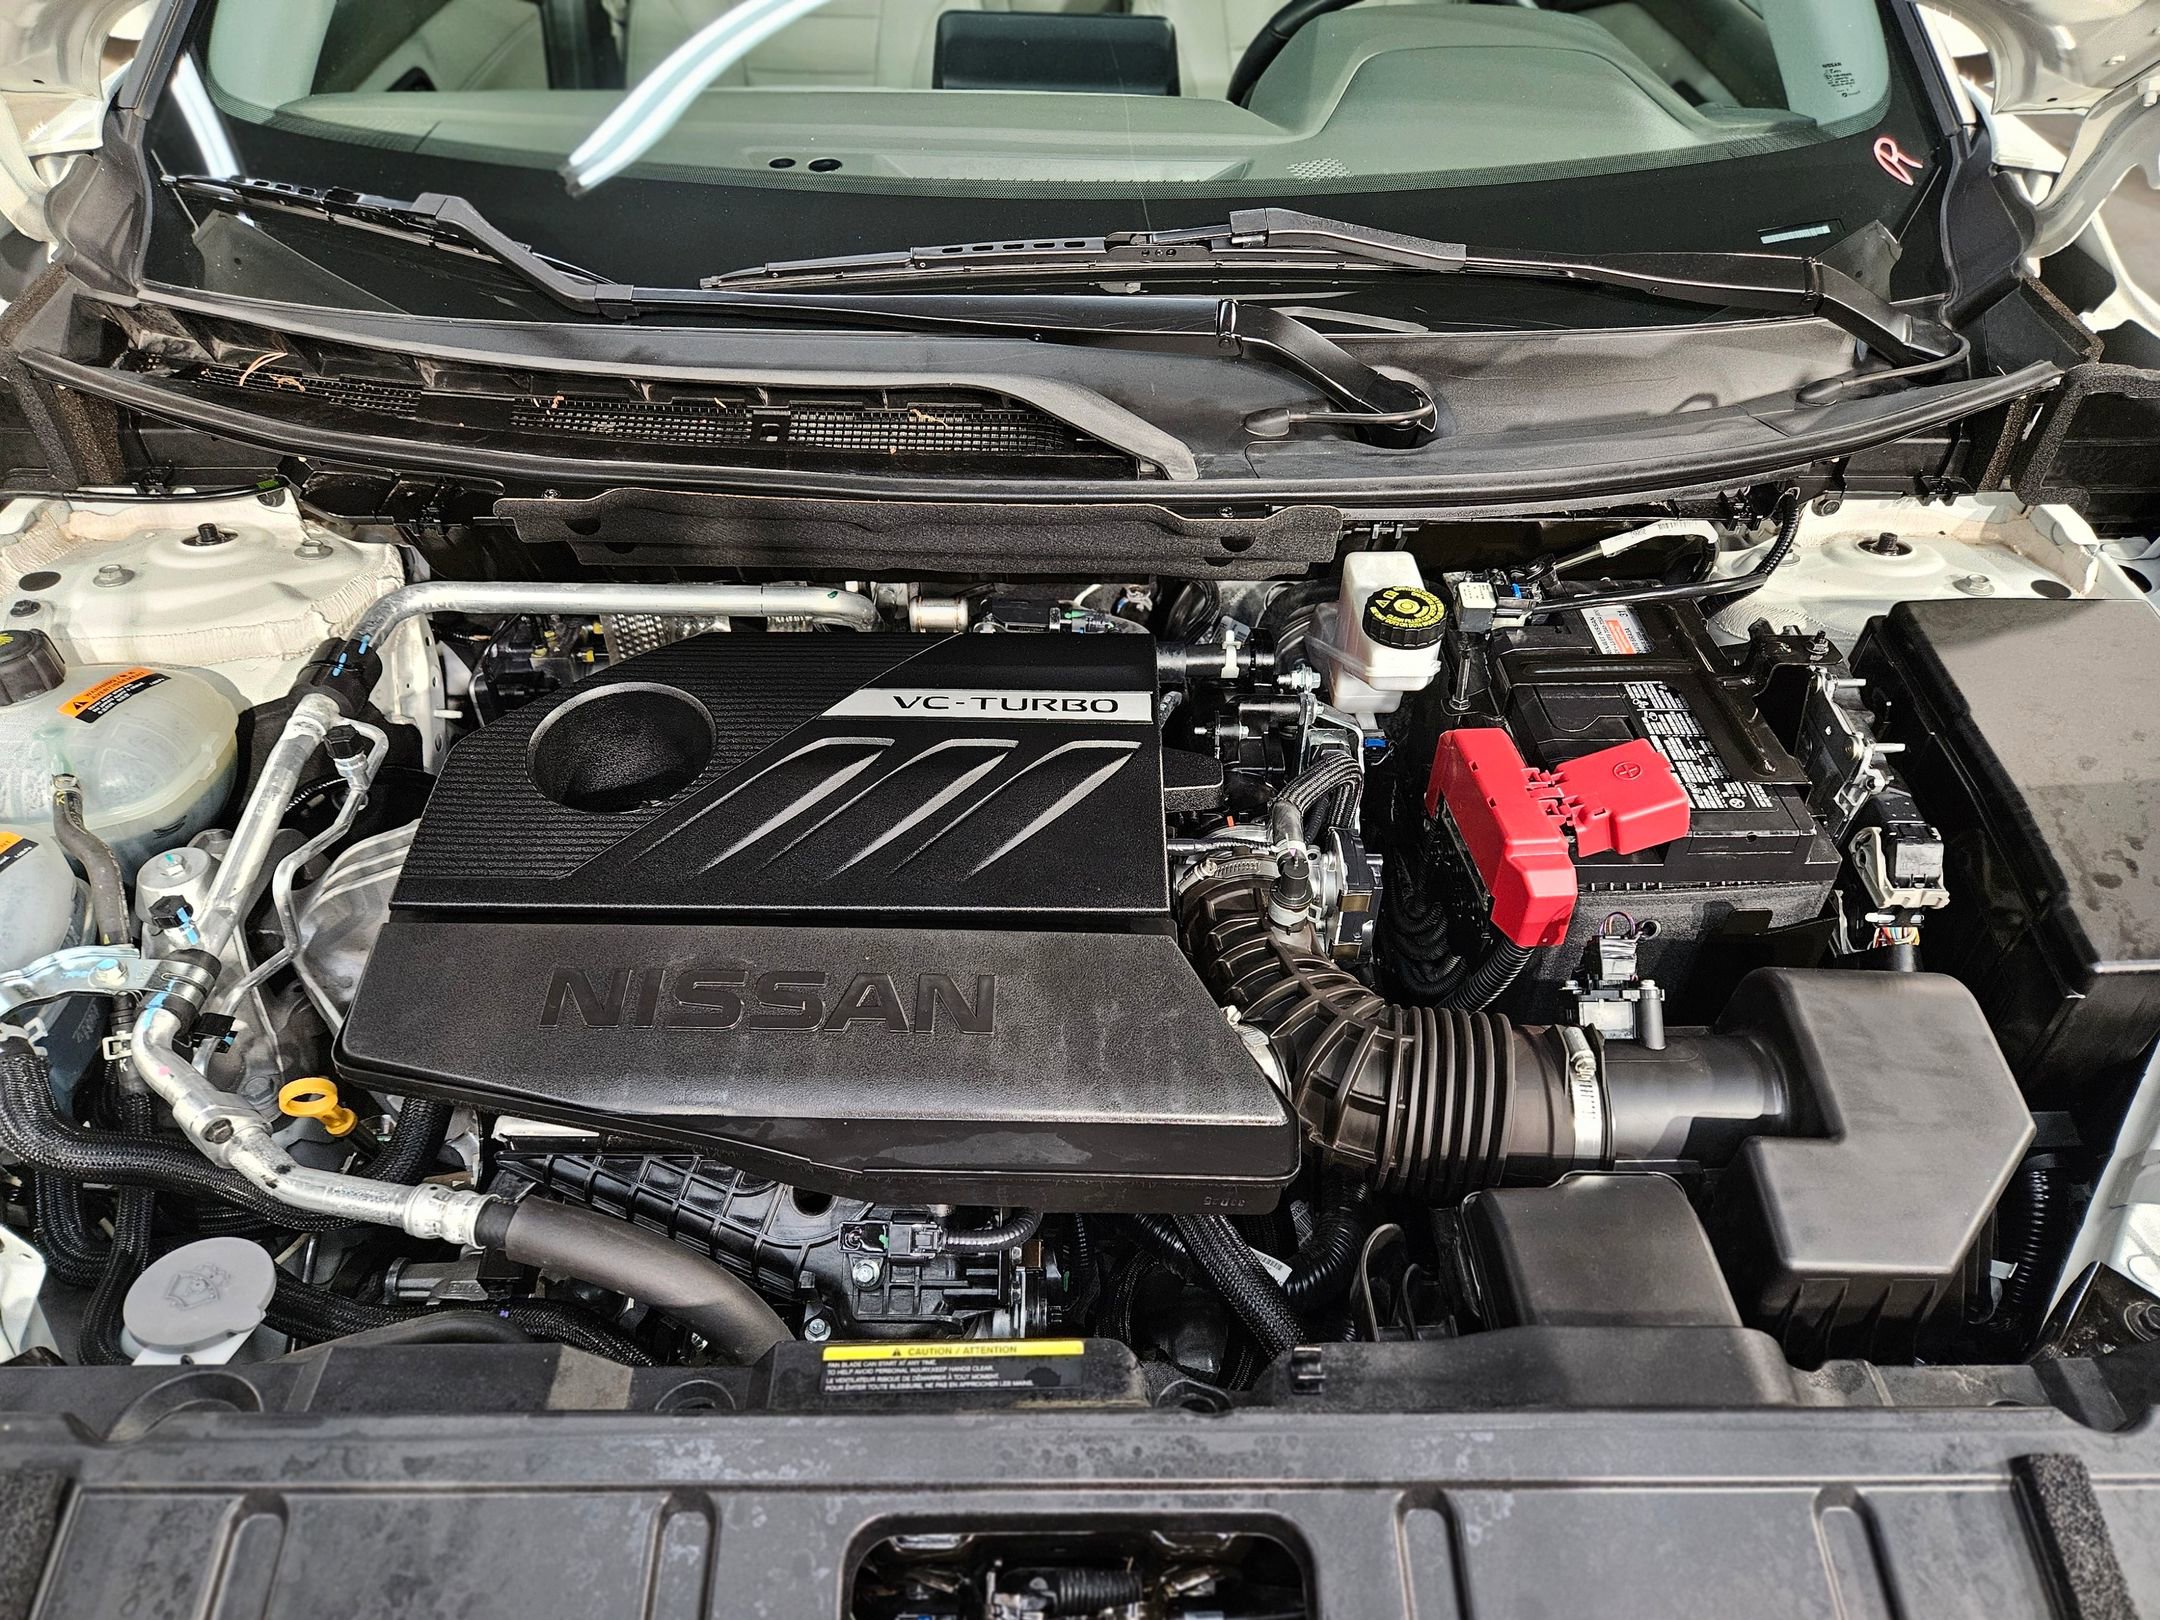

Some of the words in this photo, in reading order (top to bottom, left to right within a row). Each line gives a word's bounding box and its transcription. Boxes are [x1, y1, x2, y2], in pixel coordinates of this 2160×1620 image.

[1873, 136, 1923, 186] R
[892, 695, 1120, 714] VC-TURBO
[538, 967, 997, 1035] NISSAN
[907, 1347, 952, 1356] CAUTION
[962, 1345, 1018, 1355] ATTENTION
[862, 1360, 878, 1368] CAN
